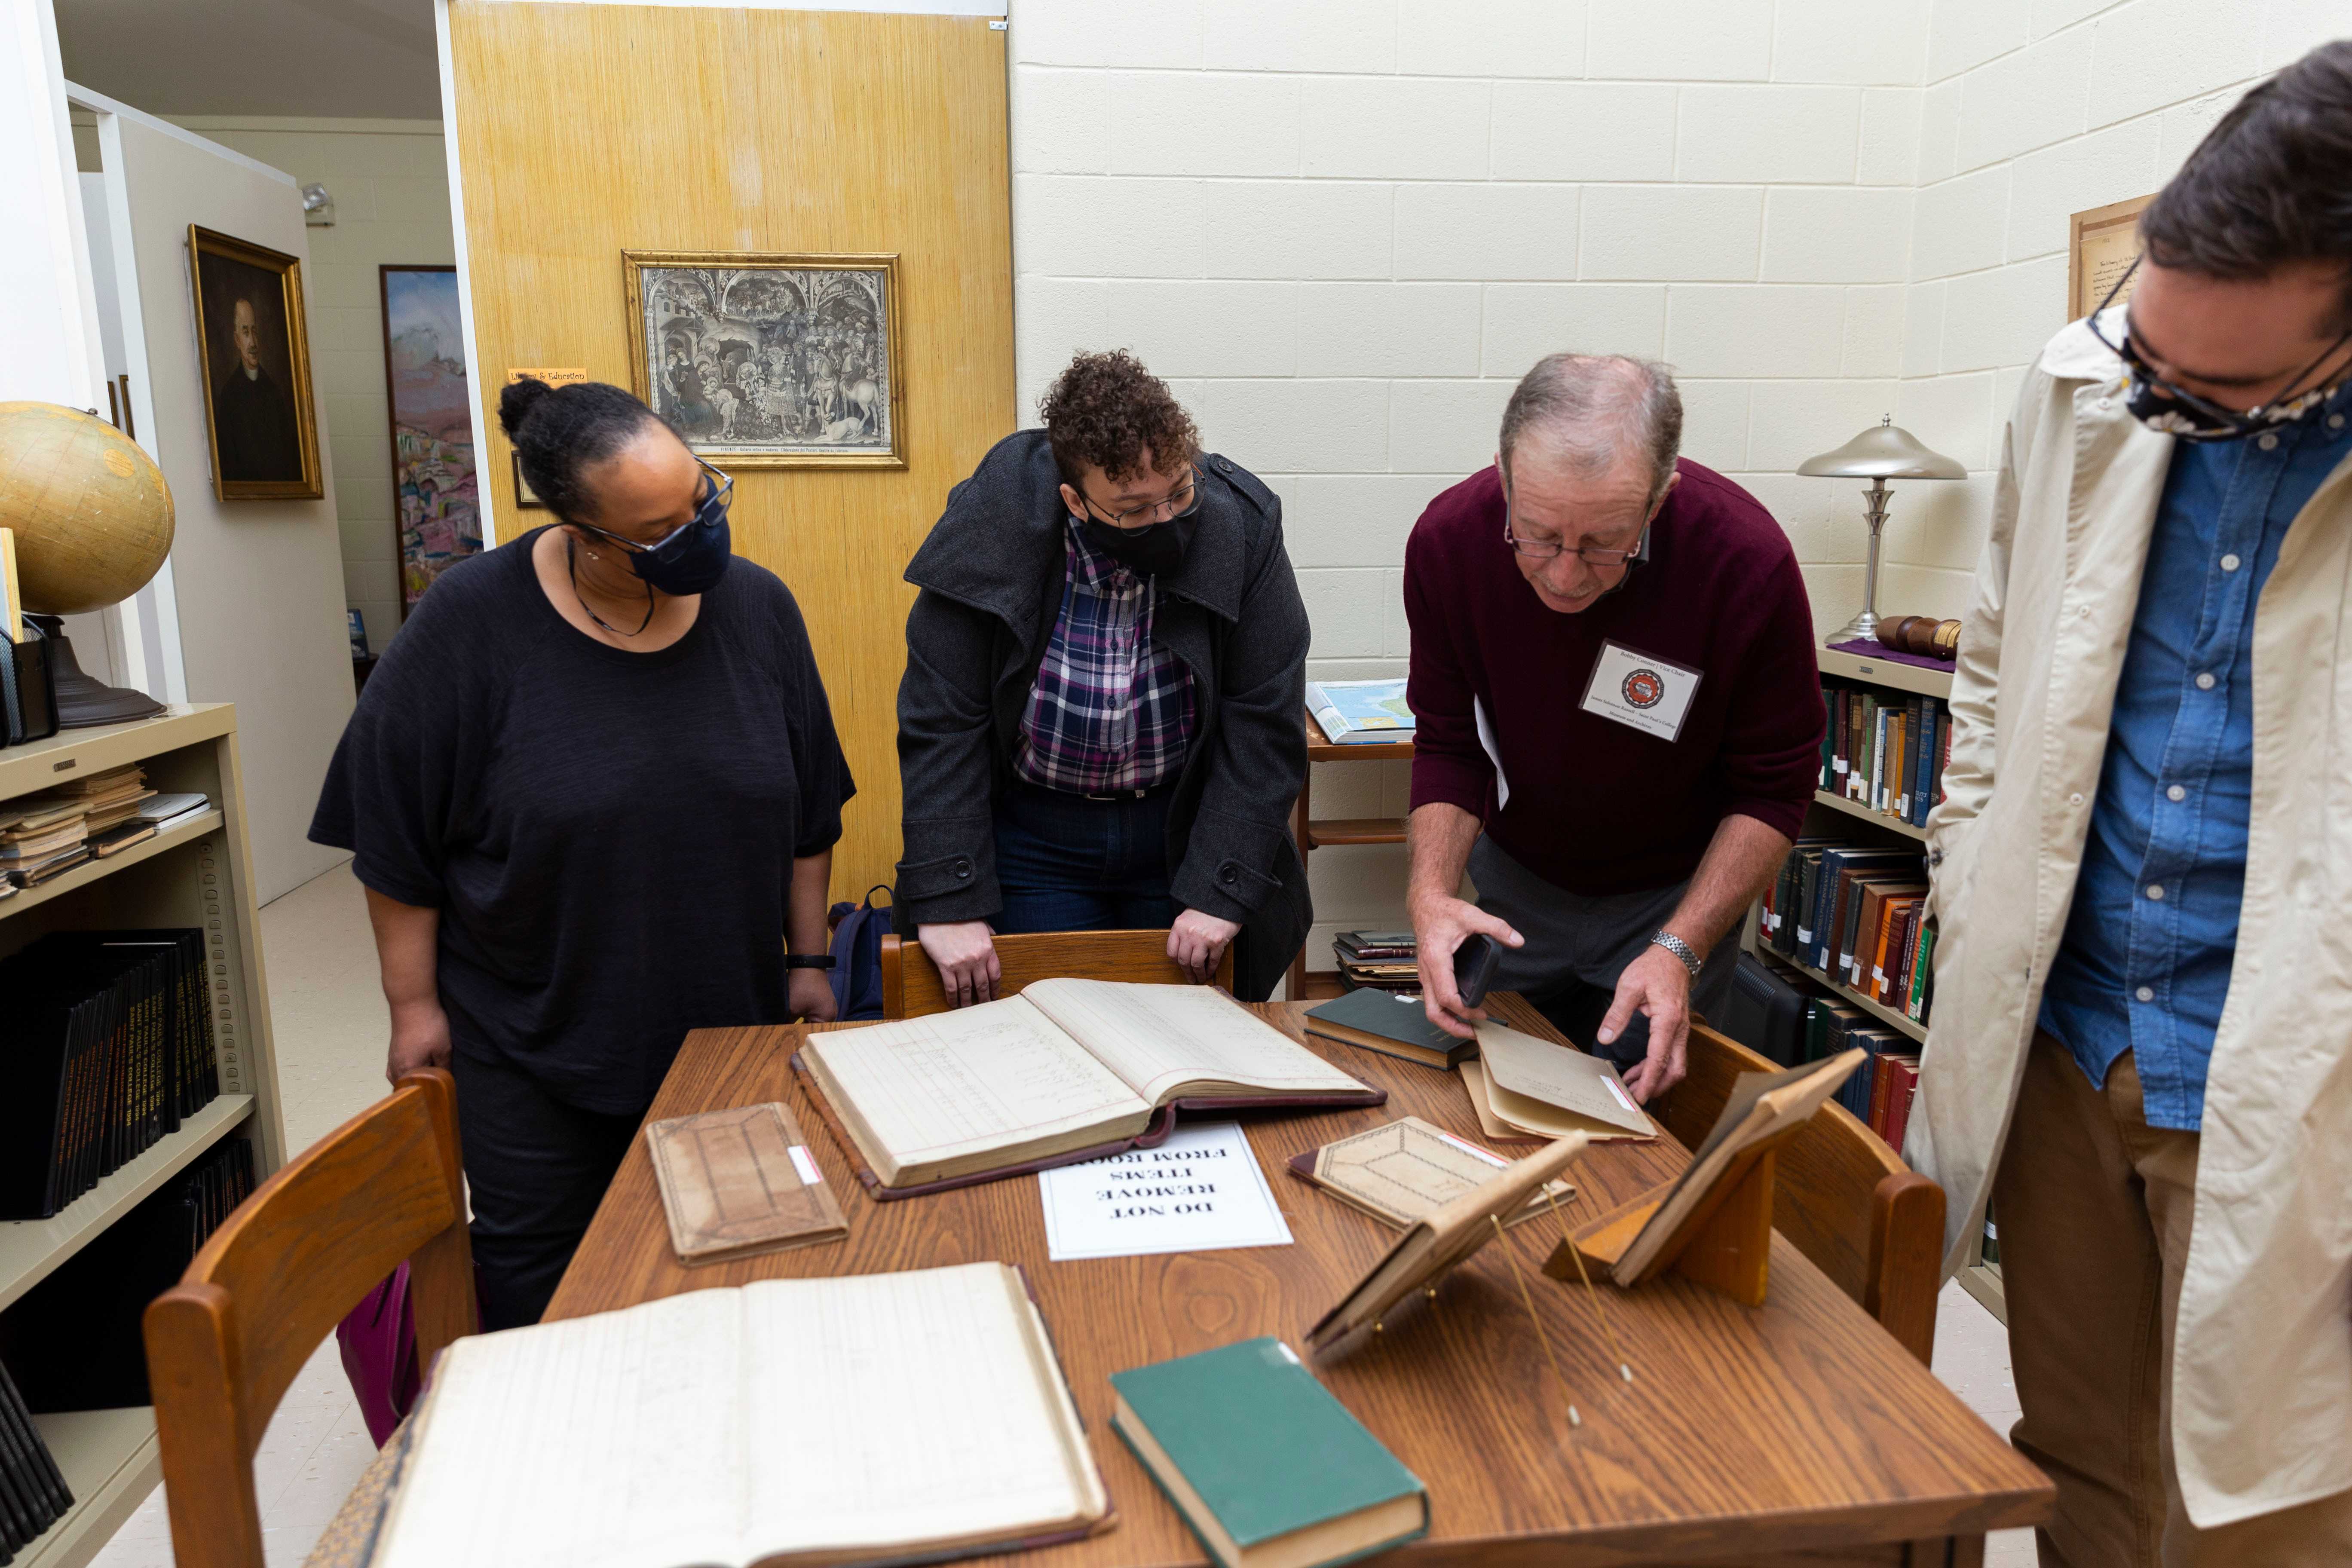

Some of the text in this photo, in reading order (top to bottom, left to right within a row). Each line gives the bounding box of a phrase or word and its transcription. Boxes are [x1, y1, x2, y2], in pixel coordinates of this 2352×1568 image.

[1620, 651, 1636, 661] Bobby
[1636, 656, 1655, 667] Conner
[1671, 668, 1685, 677] Chair
[1590, 695, 1603, 703] James
[1602, 699, 1620, 708] Solomon
[1620, 705, 1635, 714] Russell
[1661, 720, 1677, 729] College
[1608, 710, 1626, 720] Museum
[1634, 720, 1652, 729] Archives
[1078, 1148, 1228, 1165] FROM ROO
[1110, 1168, 1193, 1181] ITEMS
[1096, 1183, 1216, 1201] REMOVE
[1109, 1202, 1214, 1219] DO NOT
